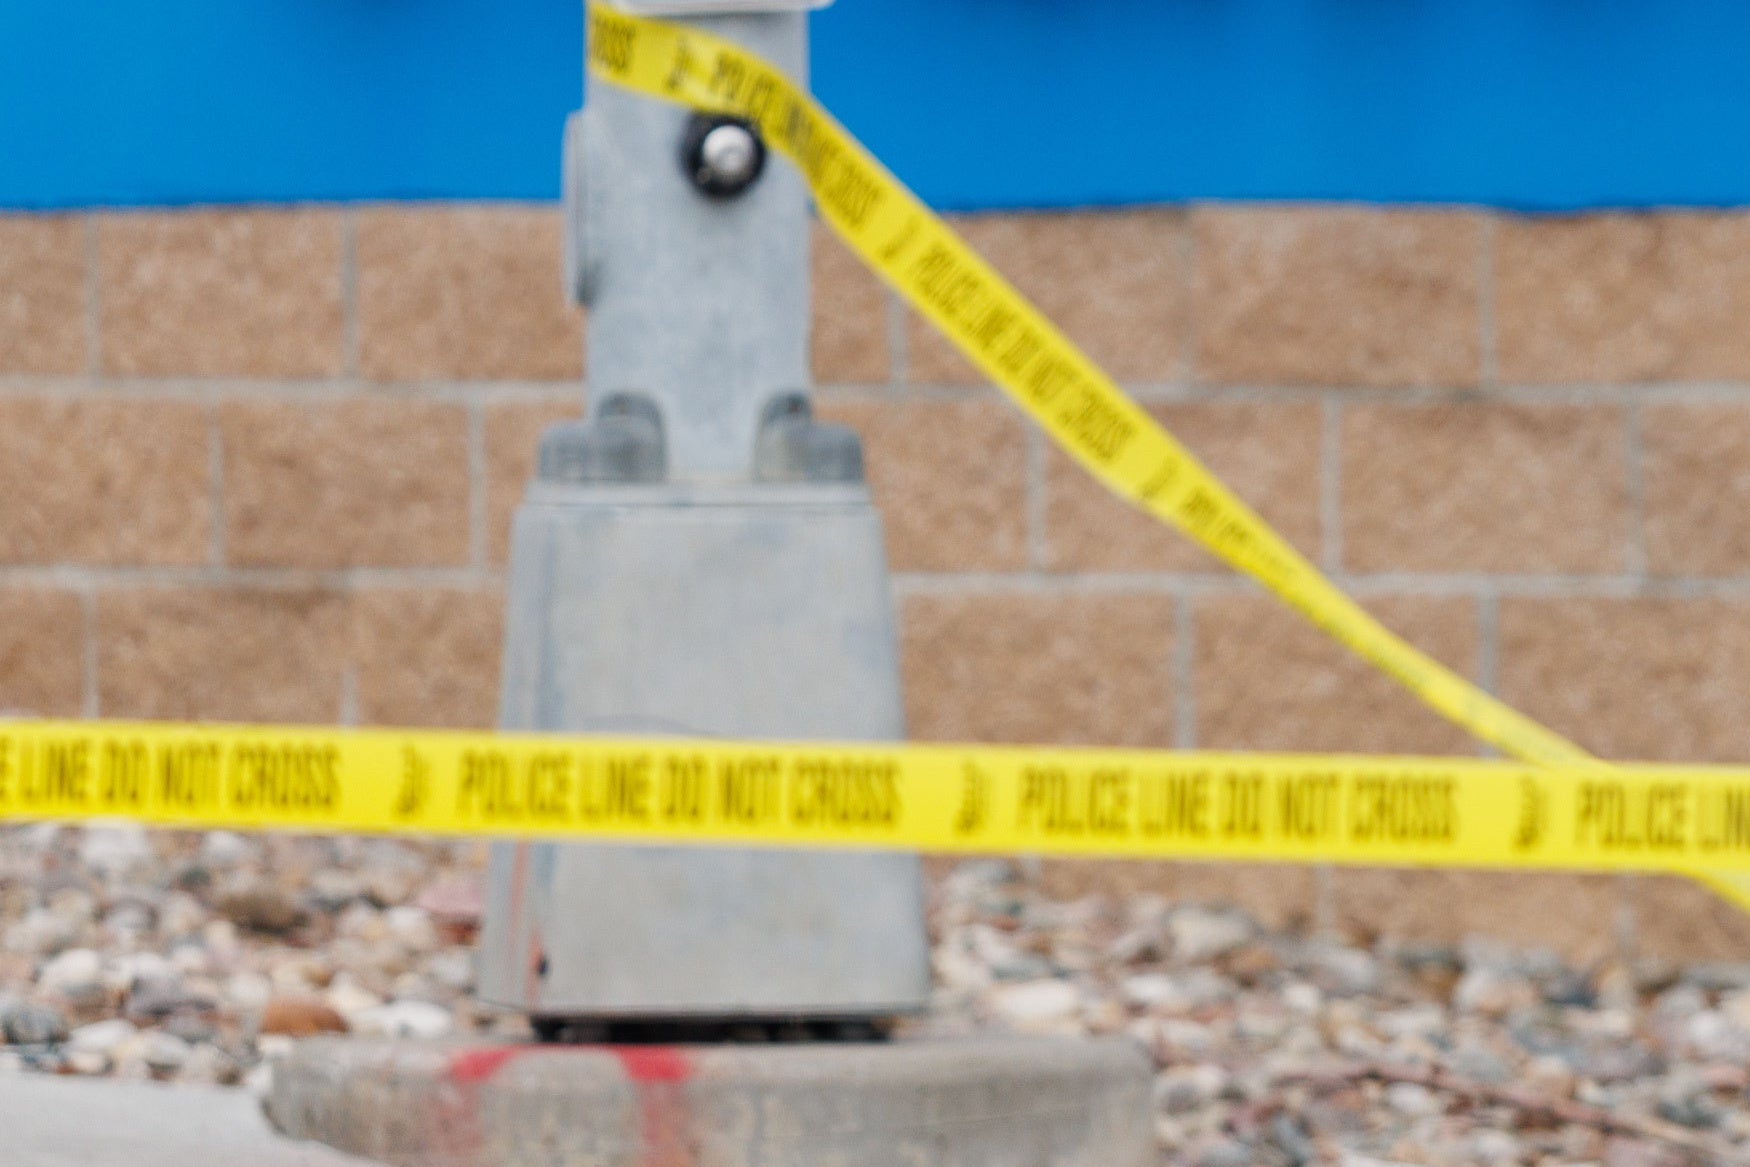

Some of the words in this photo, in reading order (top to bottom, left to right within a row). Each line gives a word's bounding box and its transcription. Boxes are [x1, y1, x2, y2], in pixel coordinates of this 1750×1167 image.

[102, 739, 149, 804] DO
[156, 740, 219, 806] NOT
[233, 741, 343, 809] CROSS
[458, 749, 573, 819] POLICE
[579, 752, 652, 822] LINE
[663, 753, 707, 823] DO
[716, 754, 779, 823] NOT
[791, 755, 899, 829] CROSS
[1016, 764, 1130, 837] POLICE
[1138, 768, 1211, 839] LINE
[1220, 770, 1265, 839] DO
[1275, 770, 1339, 840] NOT
[1349, 771, 1459, 844] CROSS
[1574, 779, 1688, 851] POLICE
